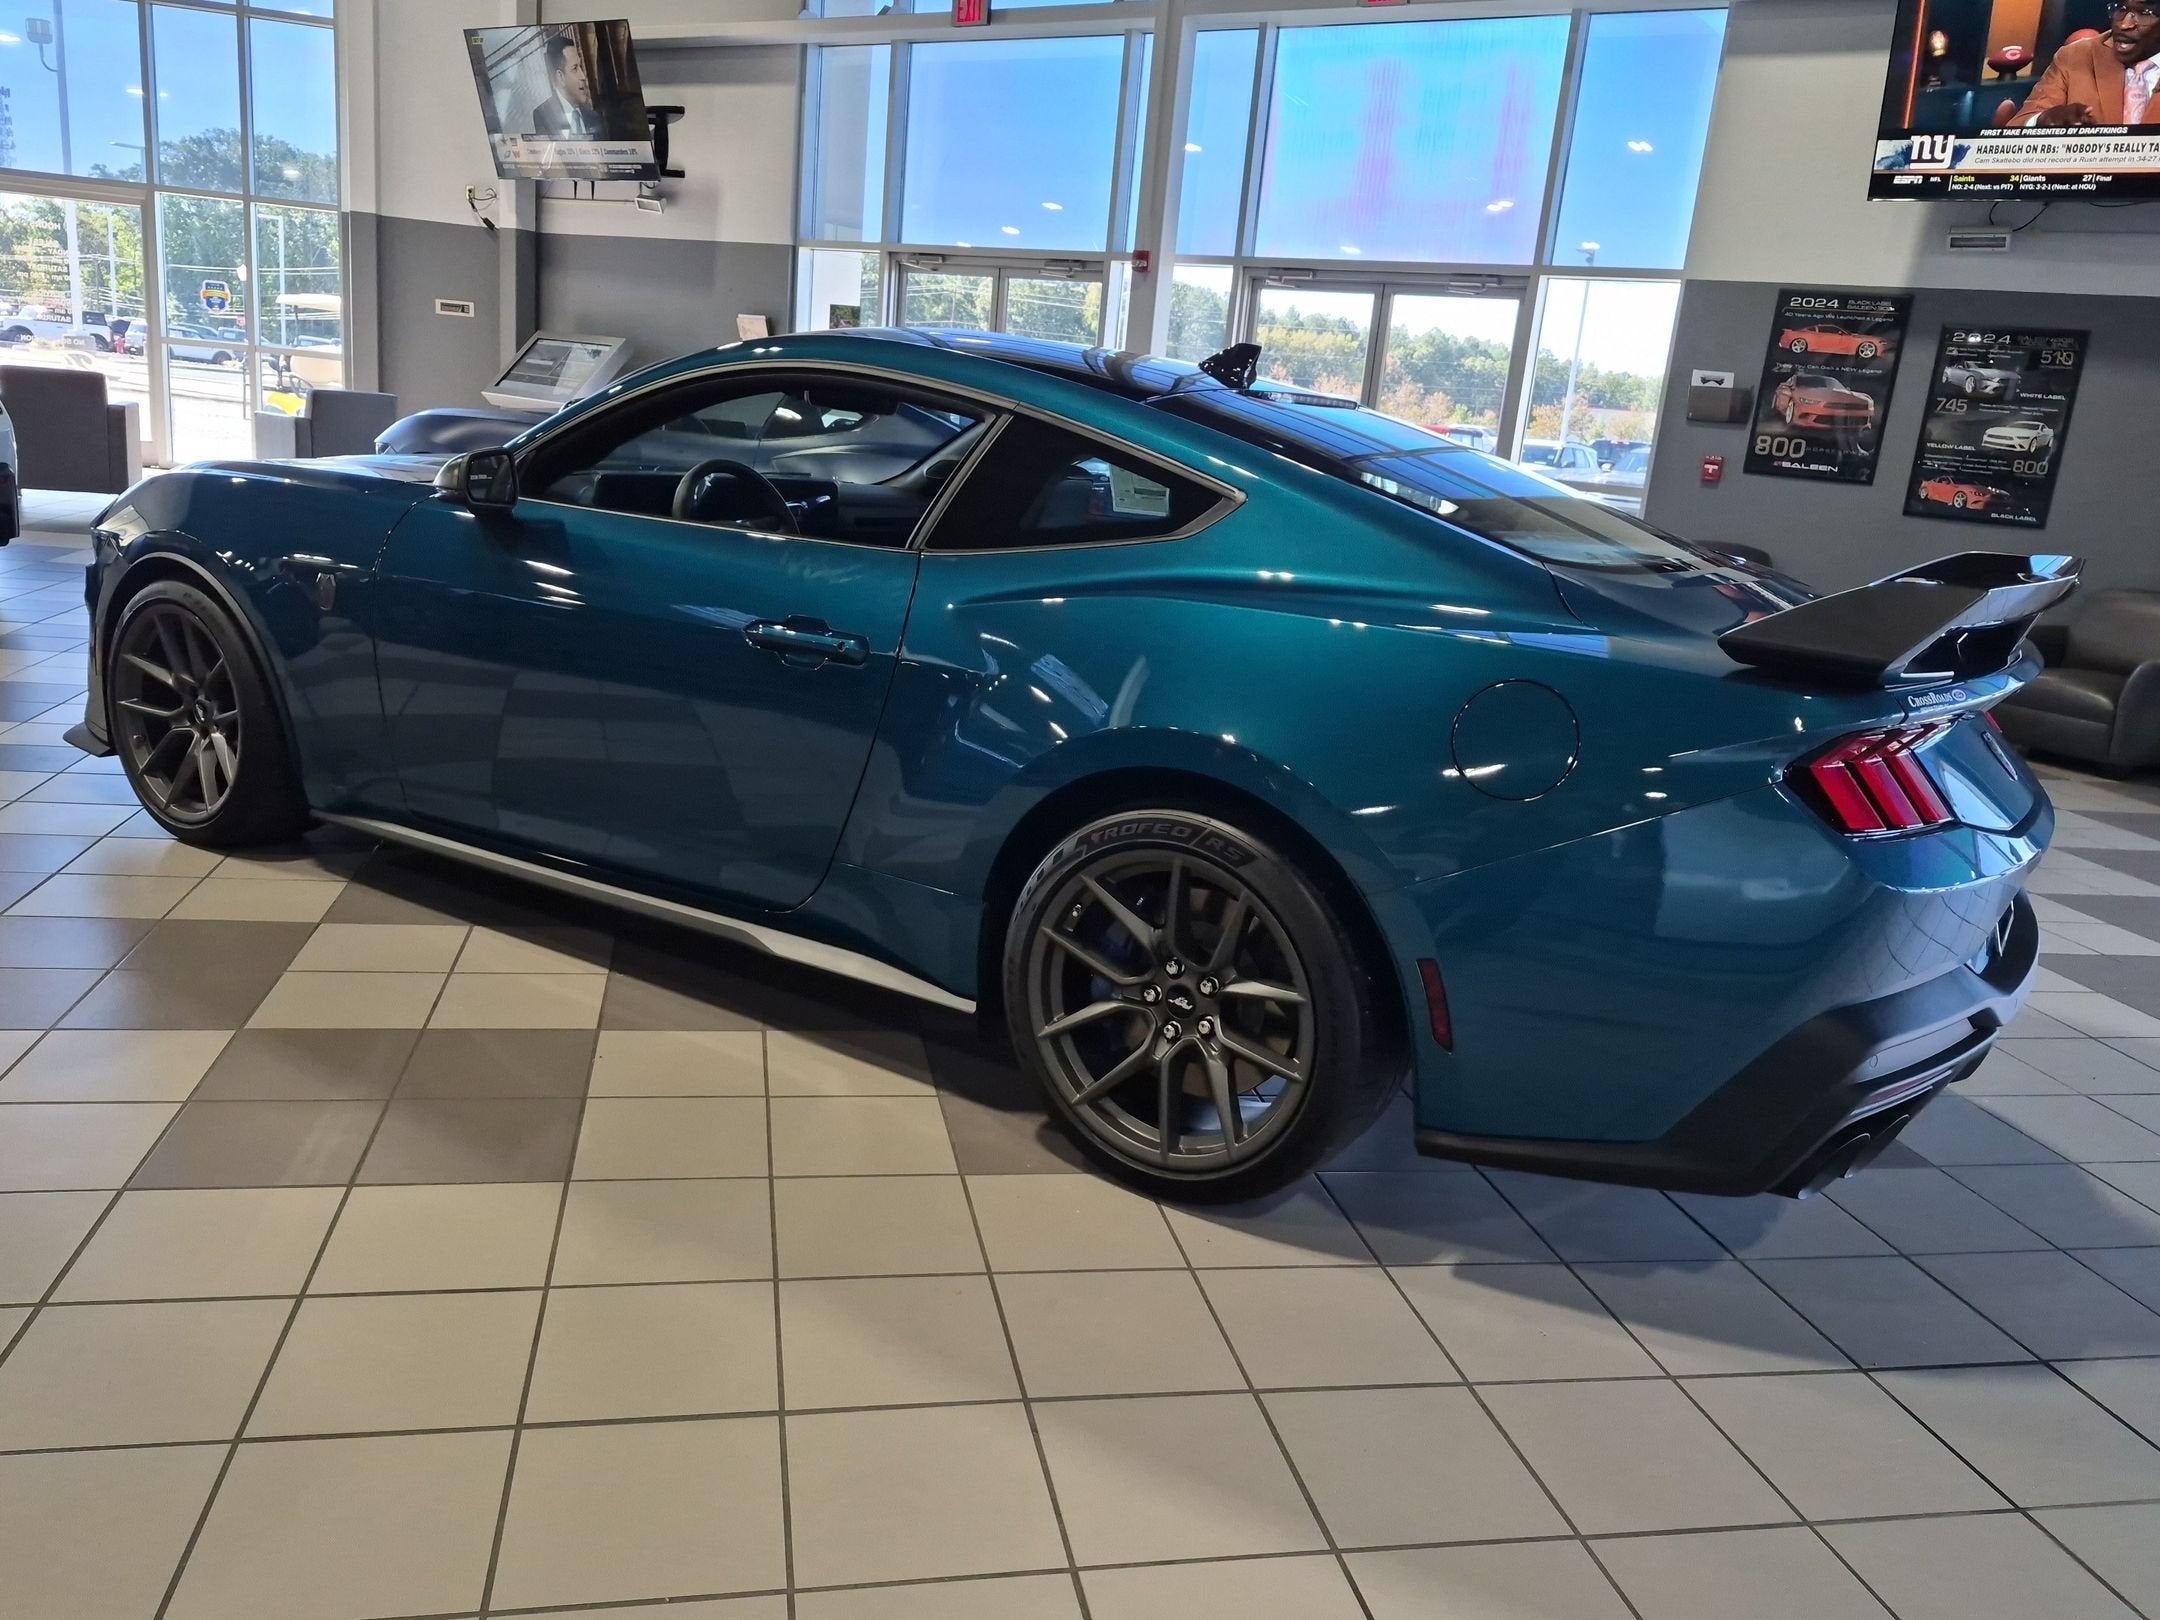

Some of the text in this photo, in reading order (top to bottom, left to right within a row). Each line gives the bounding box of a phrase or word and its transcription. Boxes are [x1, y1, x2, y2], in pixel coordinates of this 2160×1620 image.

[2021, 128, 2066, 136] PRESENTED
[2078, 127, 2128, 135] DRAFTKINGS
[1976, 144, 2023, 155] HARBAUGH
[2025, 144, 2039, 154] ON
[2040, 144, 2060, 154] RBs:
[2113, 142, 2147, 153] REALLY
[2098, 156, 2127, 164] attempt
[1893, 175, 1923, 185] ESPN
[2082, 174, 2092, 182] 27
[1790, 296, 1839, 309] 2024
[2019, 391, 2066, 401] WHITE LABEL
[1934, 397, 1968, 413] 745
[1754, 435, 1807, 459] 800
[1926, 442, 1976, 452] YELLOW LABEL
[1781, 461, 1839, 473] SALEEN
[2012, 459, 2049, 476] 800
[1990, 512, 2037, 522] BLACK LABEL
[1090, 822, 1193, 843] TROFEO
